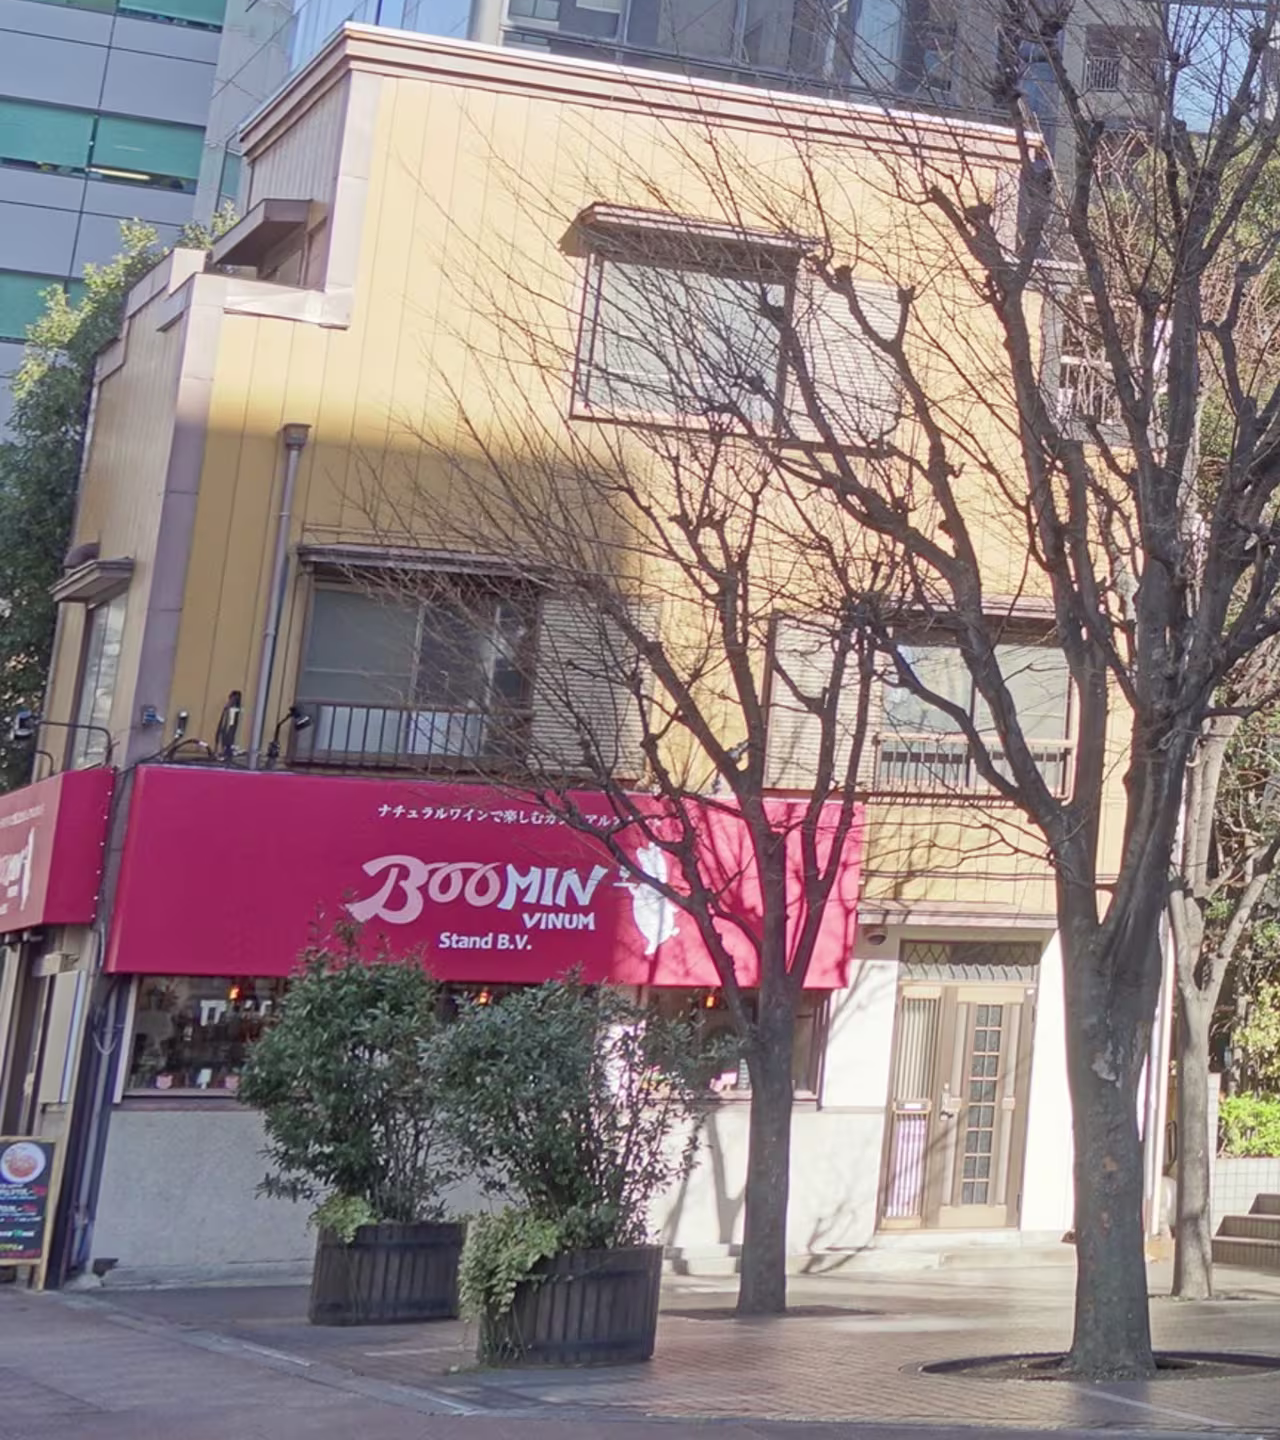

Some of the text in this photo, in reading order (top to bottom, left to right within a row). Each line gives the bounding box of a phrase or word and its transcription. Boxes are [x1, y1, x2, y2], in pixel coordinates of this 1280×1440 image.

[521, 911, 596, 931] VINUM
[438, 931, 533, 950] Stand B.V.
